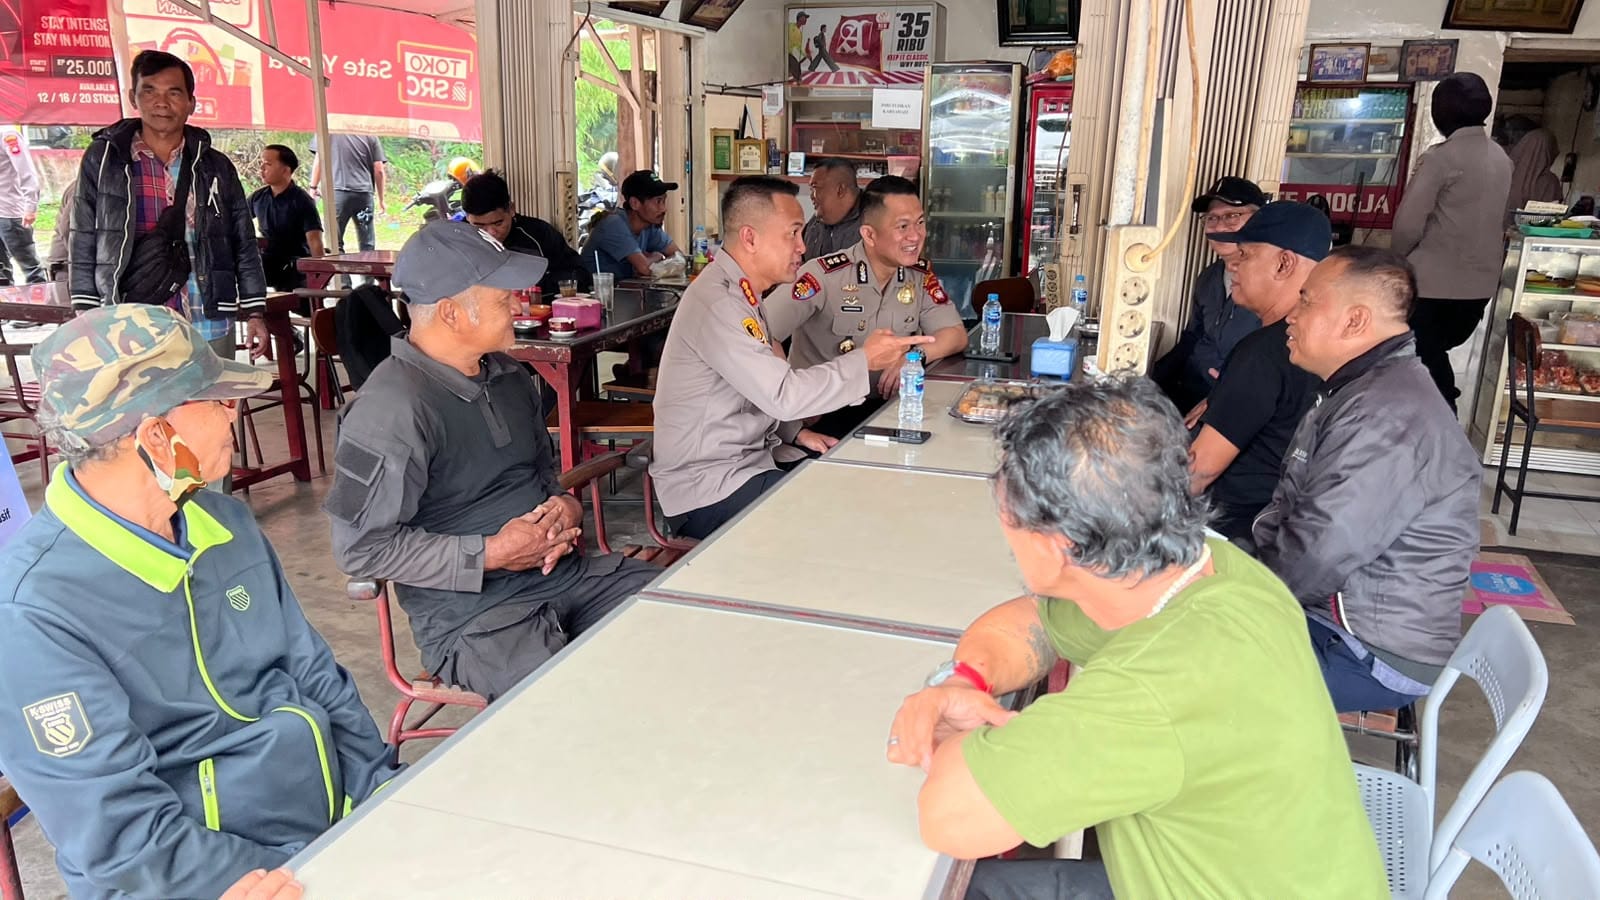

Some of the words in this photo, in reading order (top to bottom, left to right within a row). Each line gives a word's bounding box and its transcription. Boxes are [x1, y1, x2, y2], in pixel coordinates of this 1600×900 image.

[41, 16, 65, 29] STAY
[66, 17, 109, 31] INTENSE
[898, 12, 931, 38] 35
[33, 33, 57, 46] STAY
[60, 33, 71, 47] IN
[73, 34, 111, 48] MOTION
[896, 38, 925, 51] RIBU
[66, 60, 112, 76] 25.000
[37, 92, 49, 103] 12
[79, 93, 91, 103] 20
[92, 93, 119, 104] STICKS
